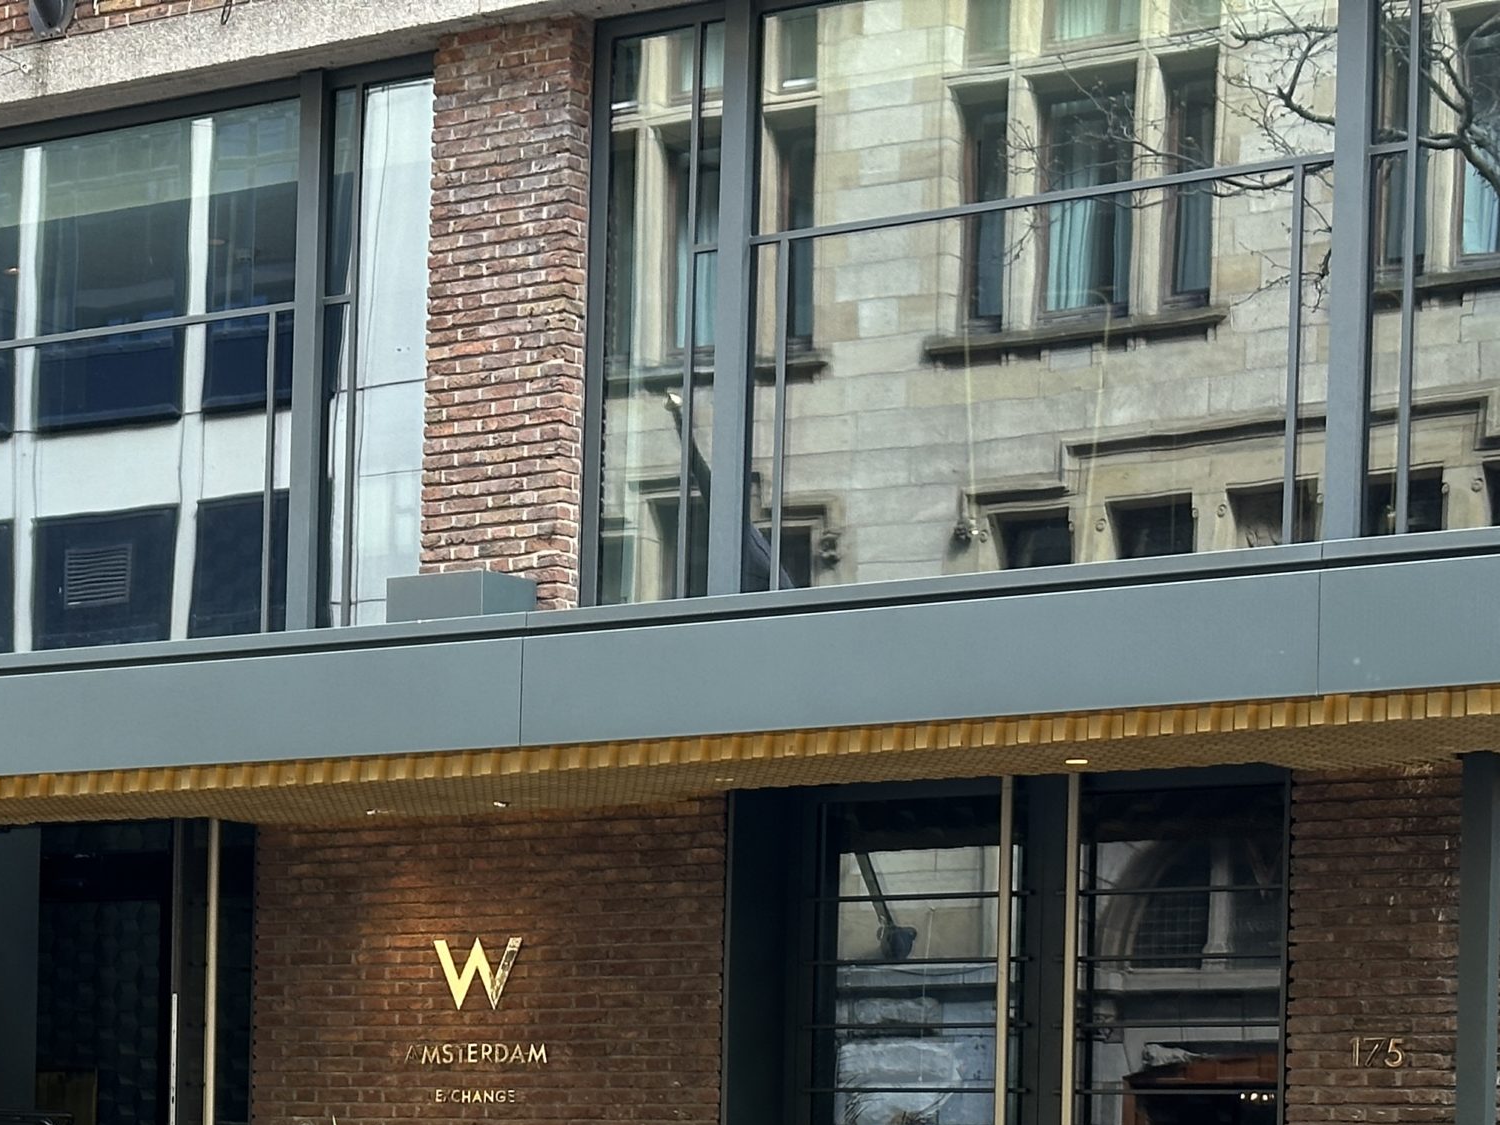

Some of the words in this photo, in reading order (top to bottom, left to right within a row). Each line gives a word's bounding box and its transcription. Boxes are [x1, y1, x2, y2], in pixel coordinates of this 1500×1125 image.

[433, 936, 523, 1011] W
[404, 1043, 548, 1065] AMSTERDAM
[1351, 1036, 1404, 1068] 175
